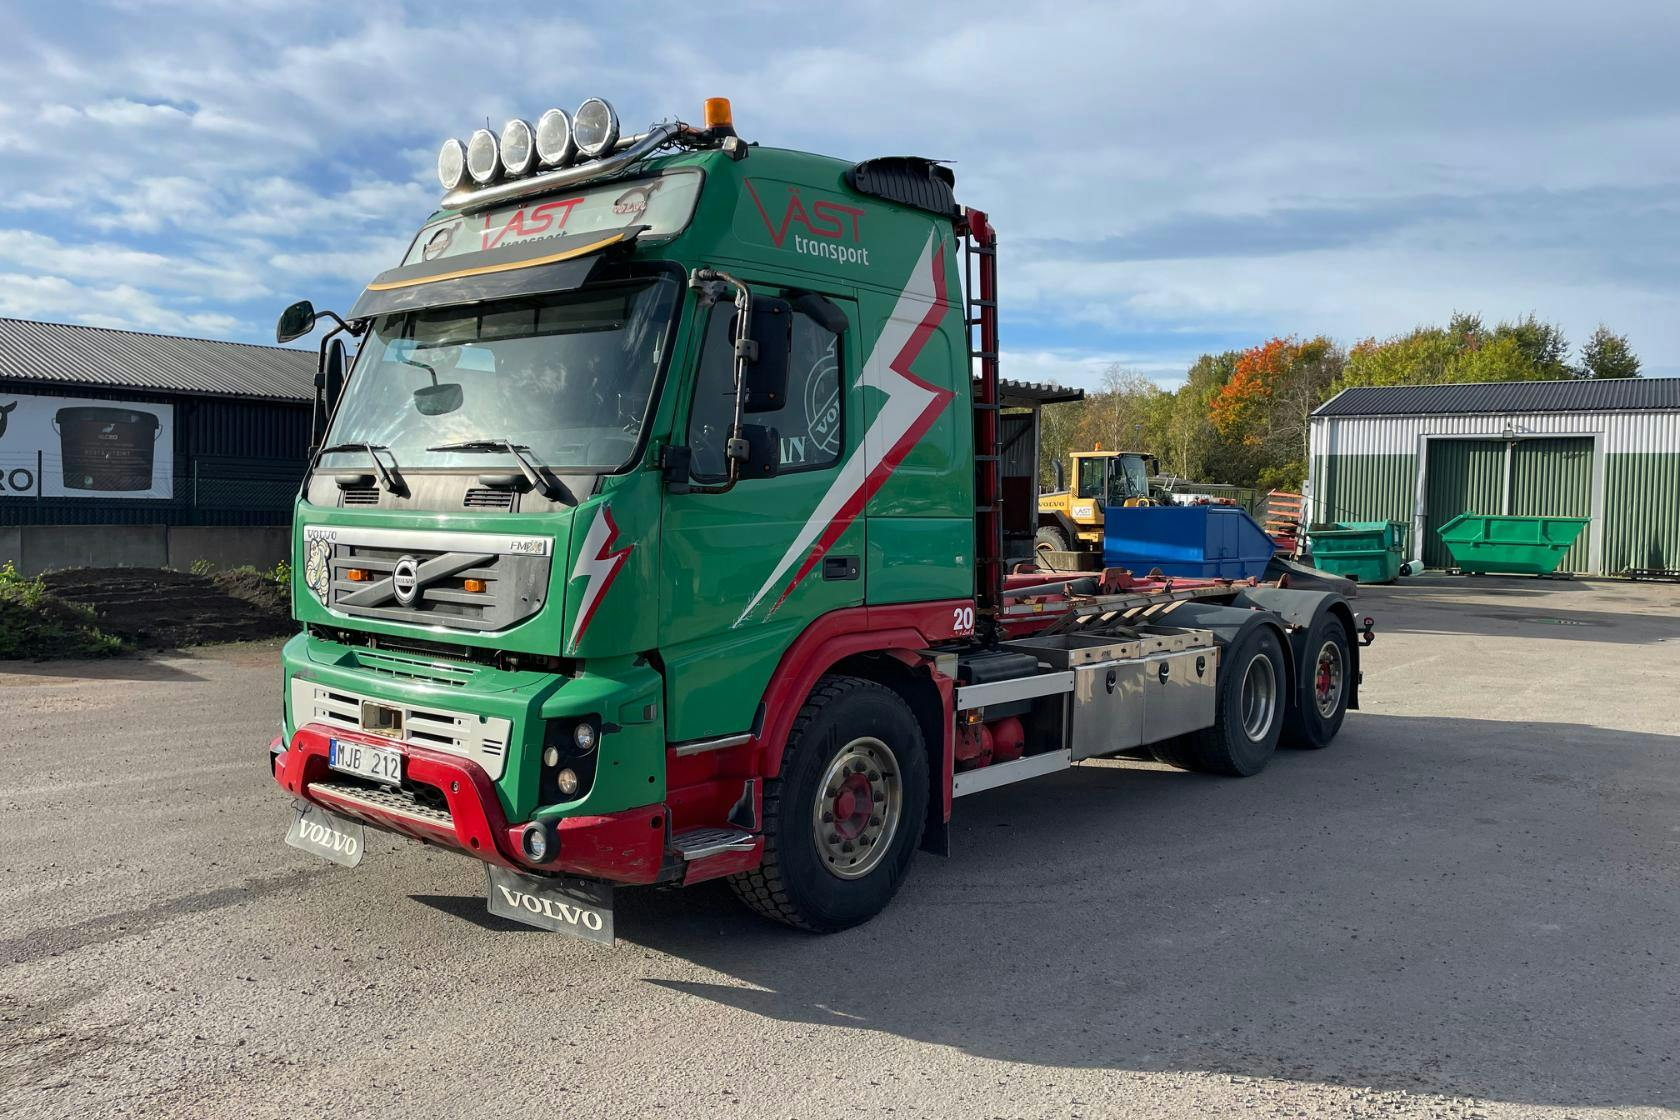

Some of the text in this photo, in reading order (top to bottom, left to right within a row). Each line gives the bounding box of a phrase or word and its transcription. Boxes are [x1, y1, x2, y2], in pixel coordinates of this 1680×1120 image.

[795, 234, 869, 266] transport
[307, 529, 337, 540] VOLVO
[953, 607, 974, 630] 20
[337, 744, 399, 779] MJB 212
[299, 818, 357, 856] VOLVO
[498, 884, 603, 931] VOLVO
